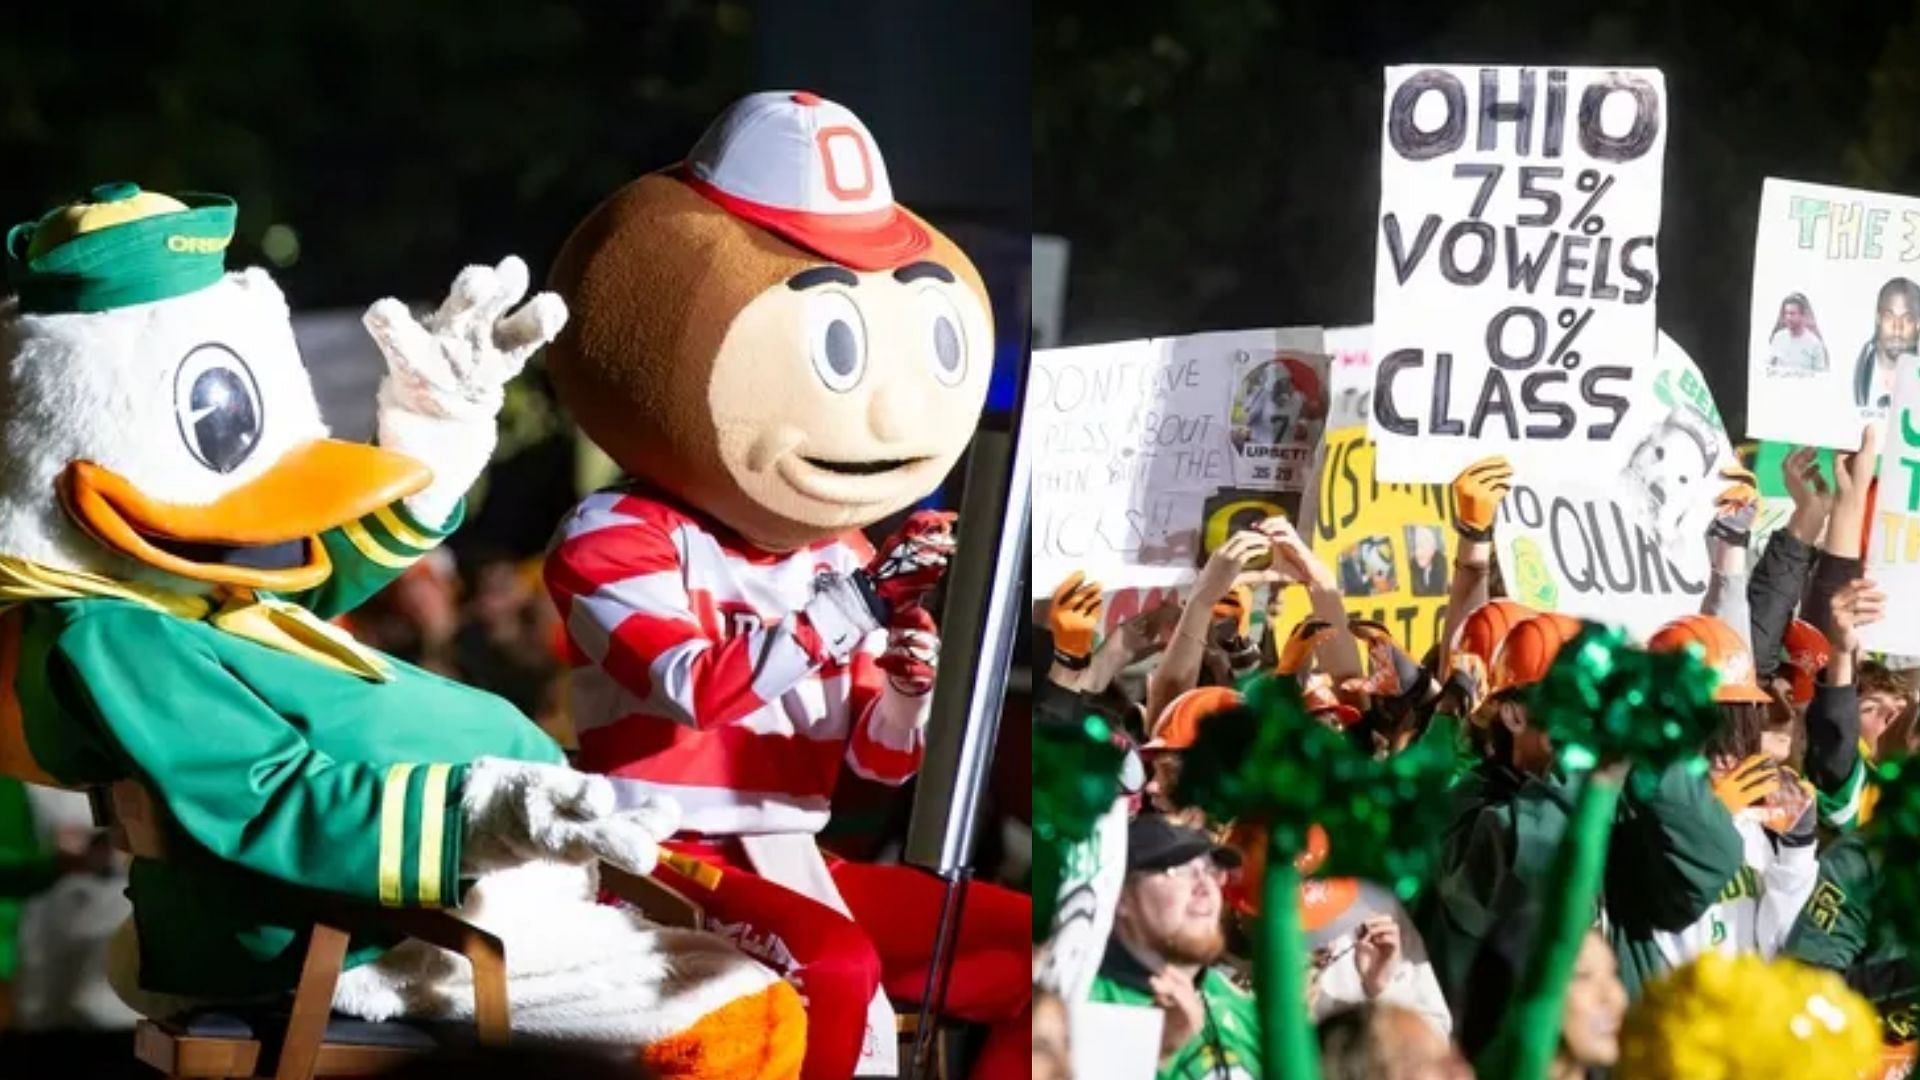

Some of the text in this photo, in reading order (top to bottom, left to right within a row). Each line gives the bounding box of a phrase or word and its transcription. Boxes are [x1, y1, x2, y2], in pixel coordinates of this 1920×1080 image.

[816, 126, 874, 202] O
[1452, 163, 1616, 236] 75%
[1382, 212, 1655, 305] VOWELS
[1788, 195, 1890, 260] THE
[1373, 348, 1634, 441] CLASS
[1166, 448, 1221, 480] THE
